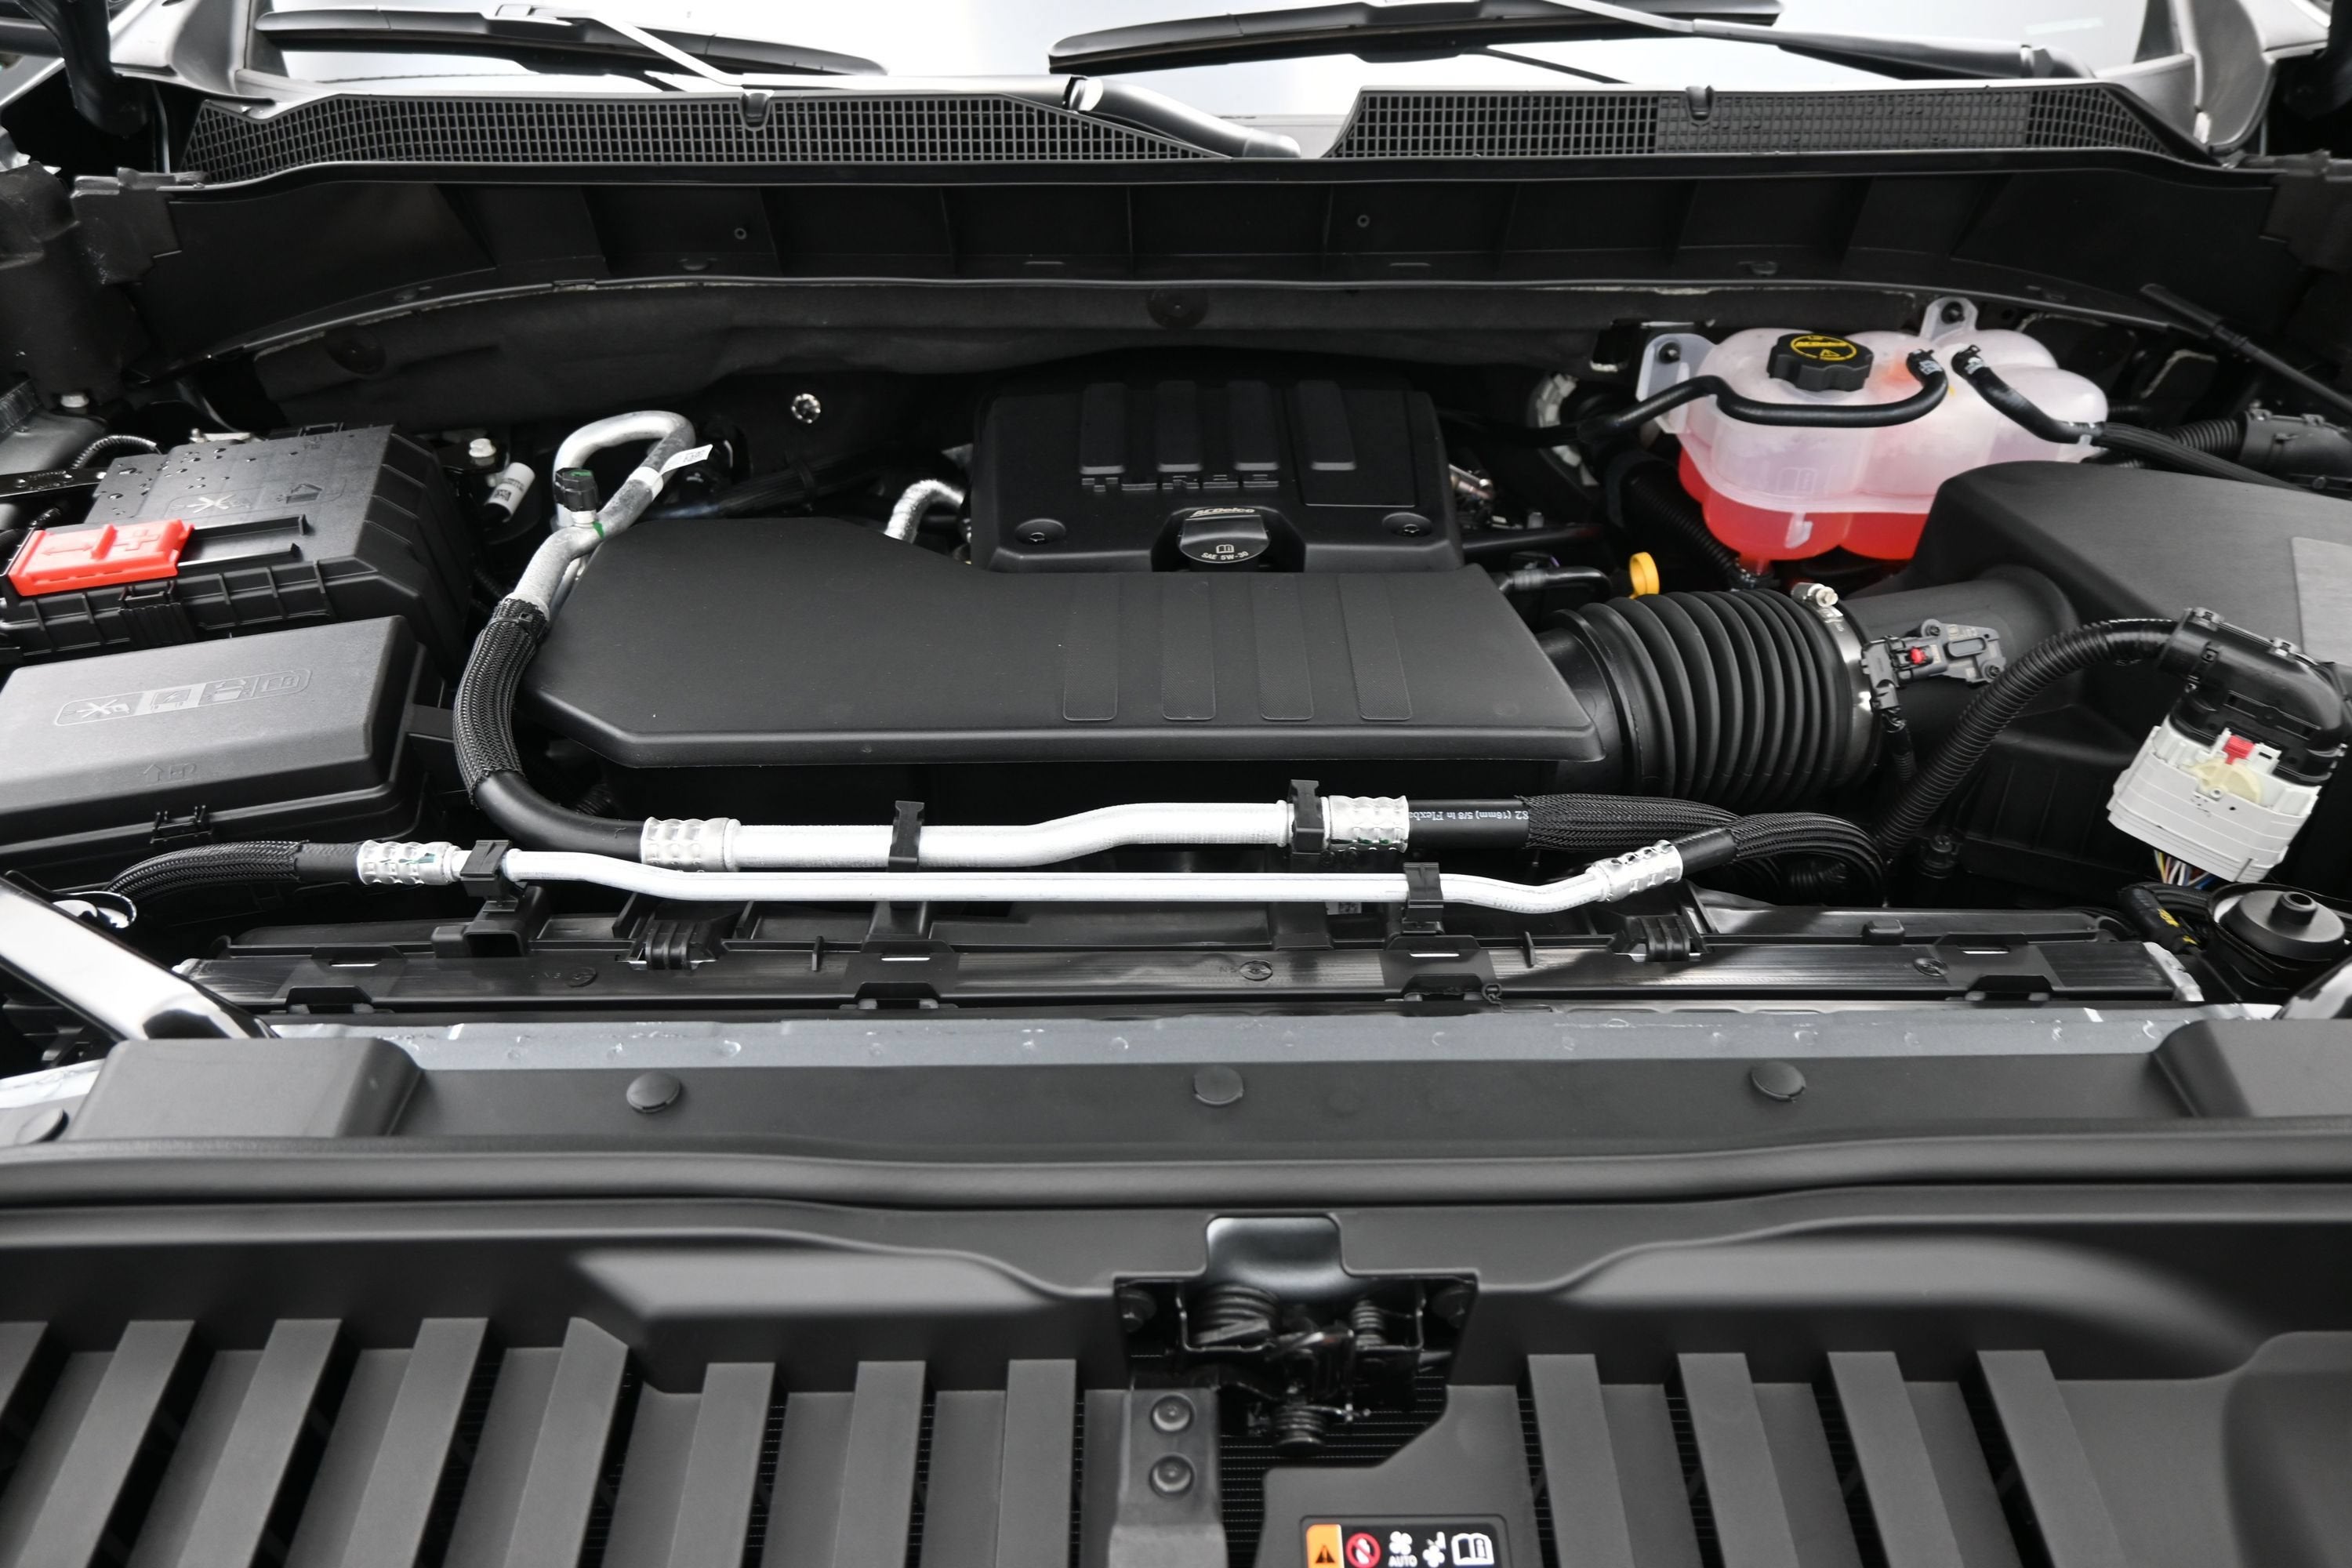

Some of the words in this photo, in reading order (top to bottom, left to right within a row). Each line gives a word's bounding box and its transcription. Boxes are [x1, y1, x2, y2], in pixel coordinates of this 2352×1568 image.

[1189, 507, 1255, 517] ACDelco
[1220, 551, 1249, 561] 5W-30
[1475, 810, 1512, 820] (16mm)
[1388, 1555, 1417, 1567] AUTO
